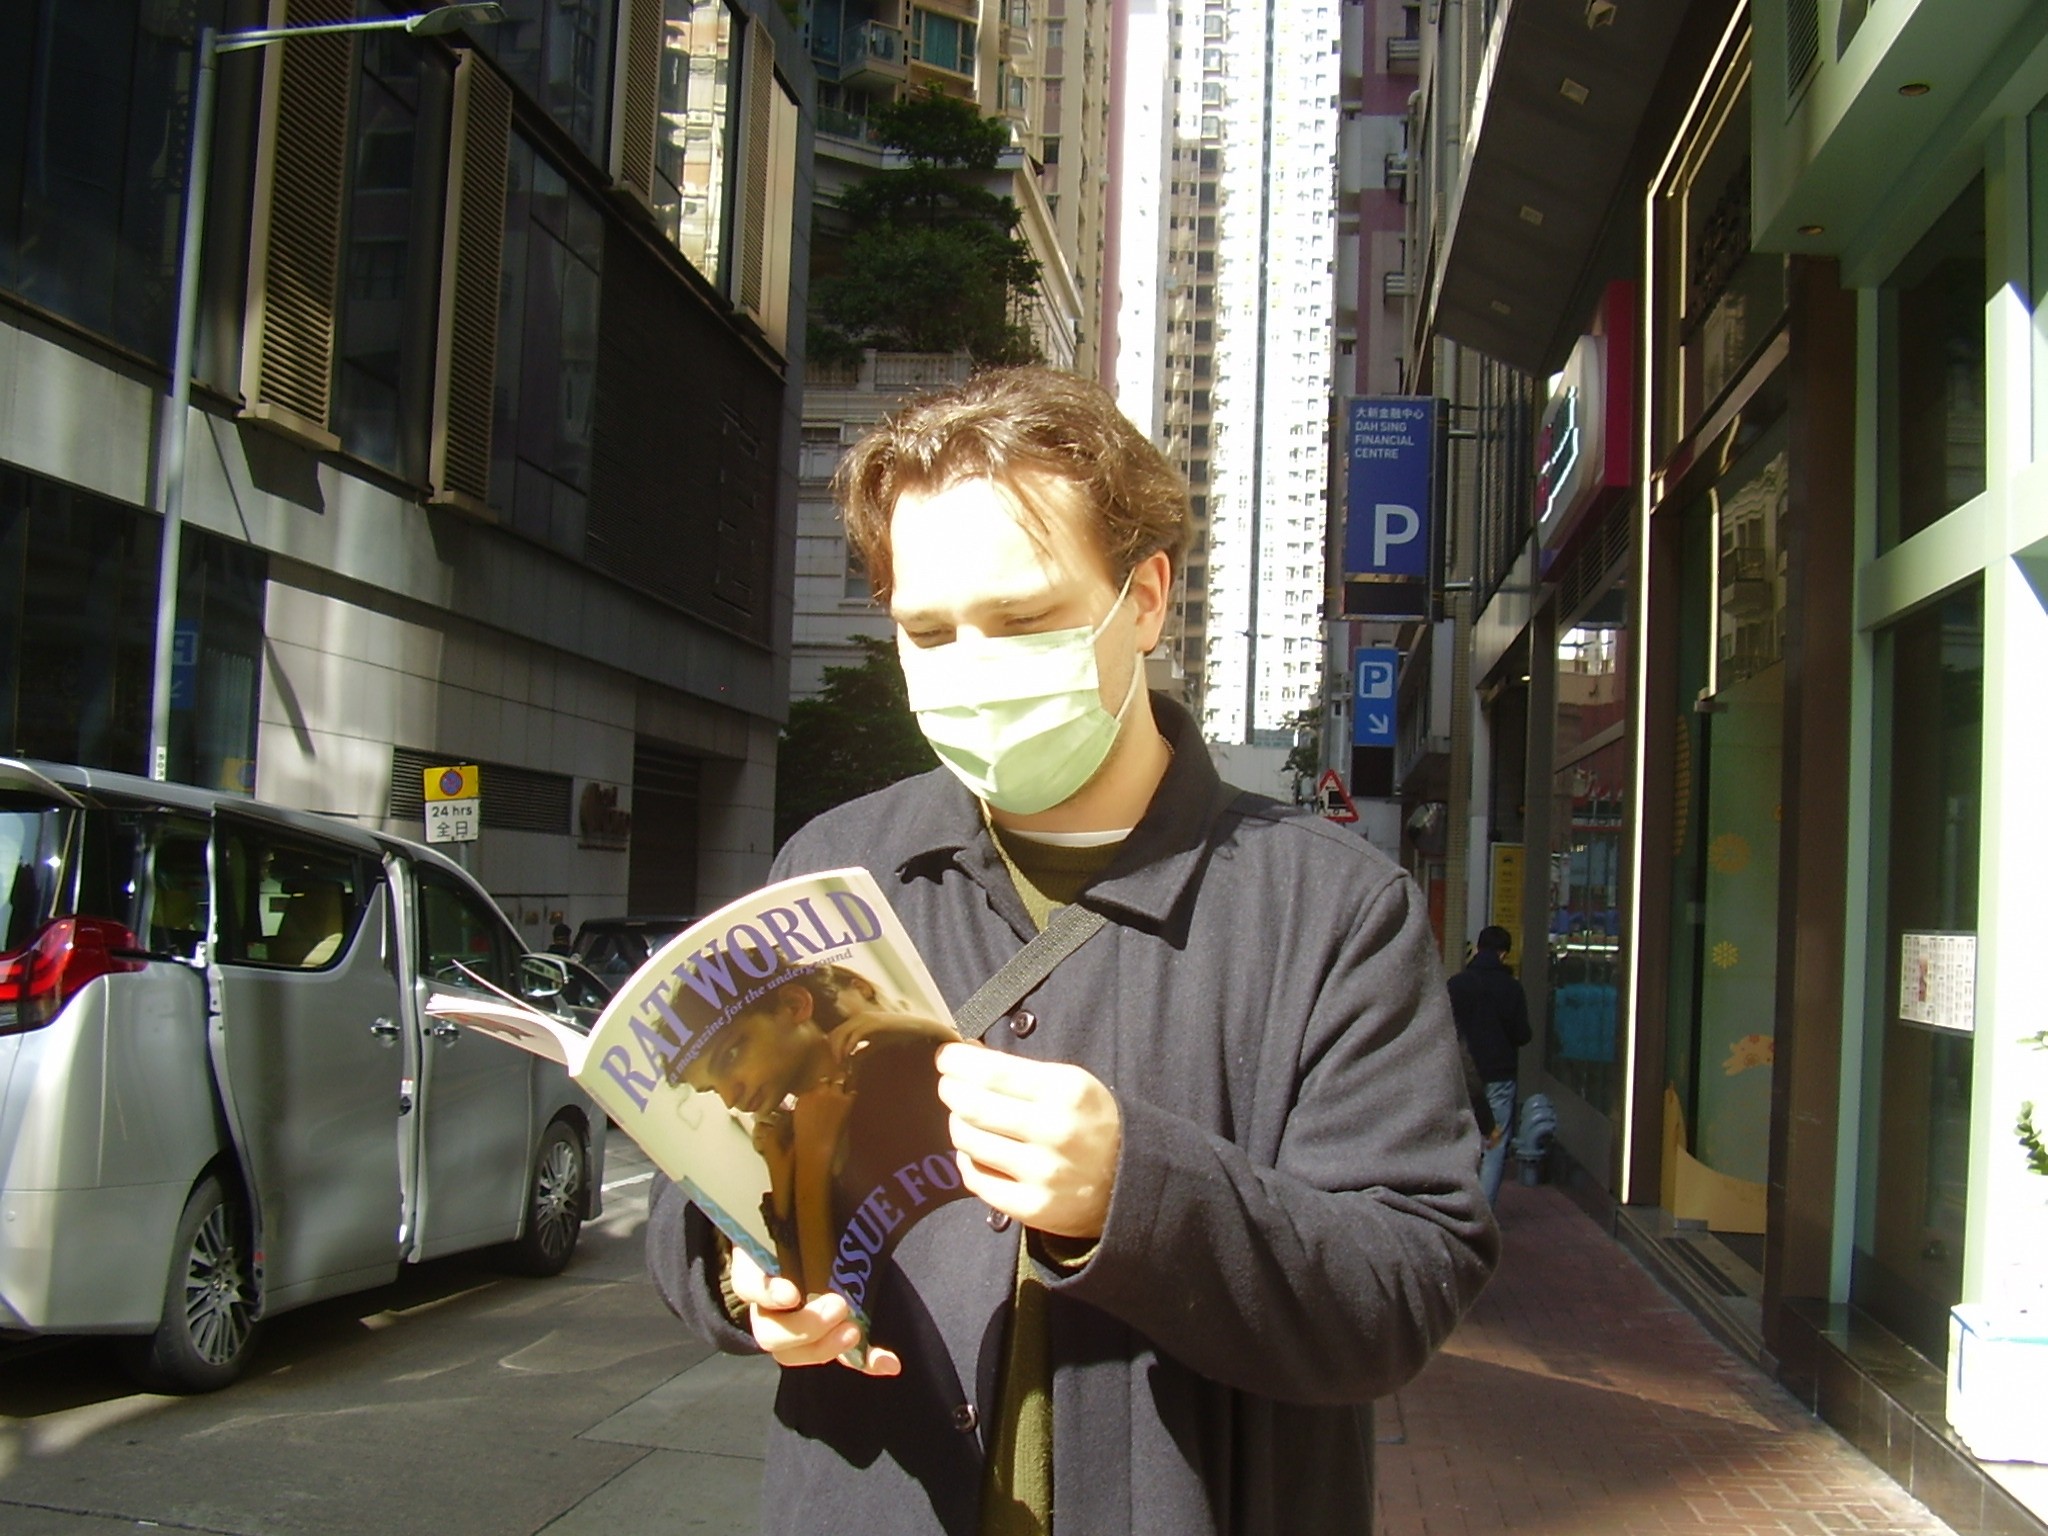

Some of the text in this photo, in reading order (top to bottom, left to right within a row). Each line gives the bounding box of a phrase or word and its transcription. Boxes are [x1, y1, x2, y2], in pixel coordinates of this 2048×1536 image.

[1355, 407, 1424, 420] 大新金融中心
[1355, 421, 1407, 432] DAH SING
[1355, 434, 1415, 446] FINANCIAL
[1355, 447, 1399, 459] CENTRE
[1373, 503, 1420, 567] P
[1363, 665, 1388, 695] P
[431, 805, 472, 817] 24 hrs
[436, 821, 468, 838] 全日
[600, 890, 884, 1114] RAT WORLD
[675, 1017, 725, 1074] magazine
[723, 1001, 743, 1024] for
[744, 984, 766, 1004] the
[767, 948, 853, 991] underground
[893, 1150, 962, 1207] FO
